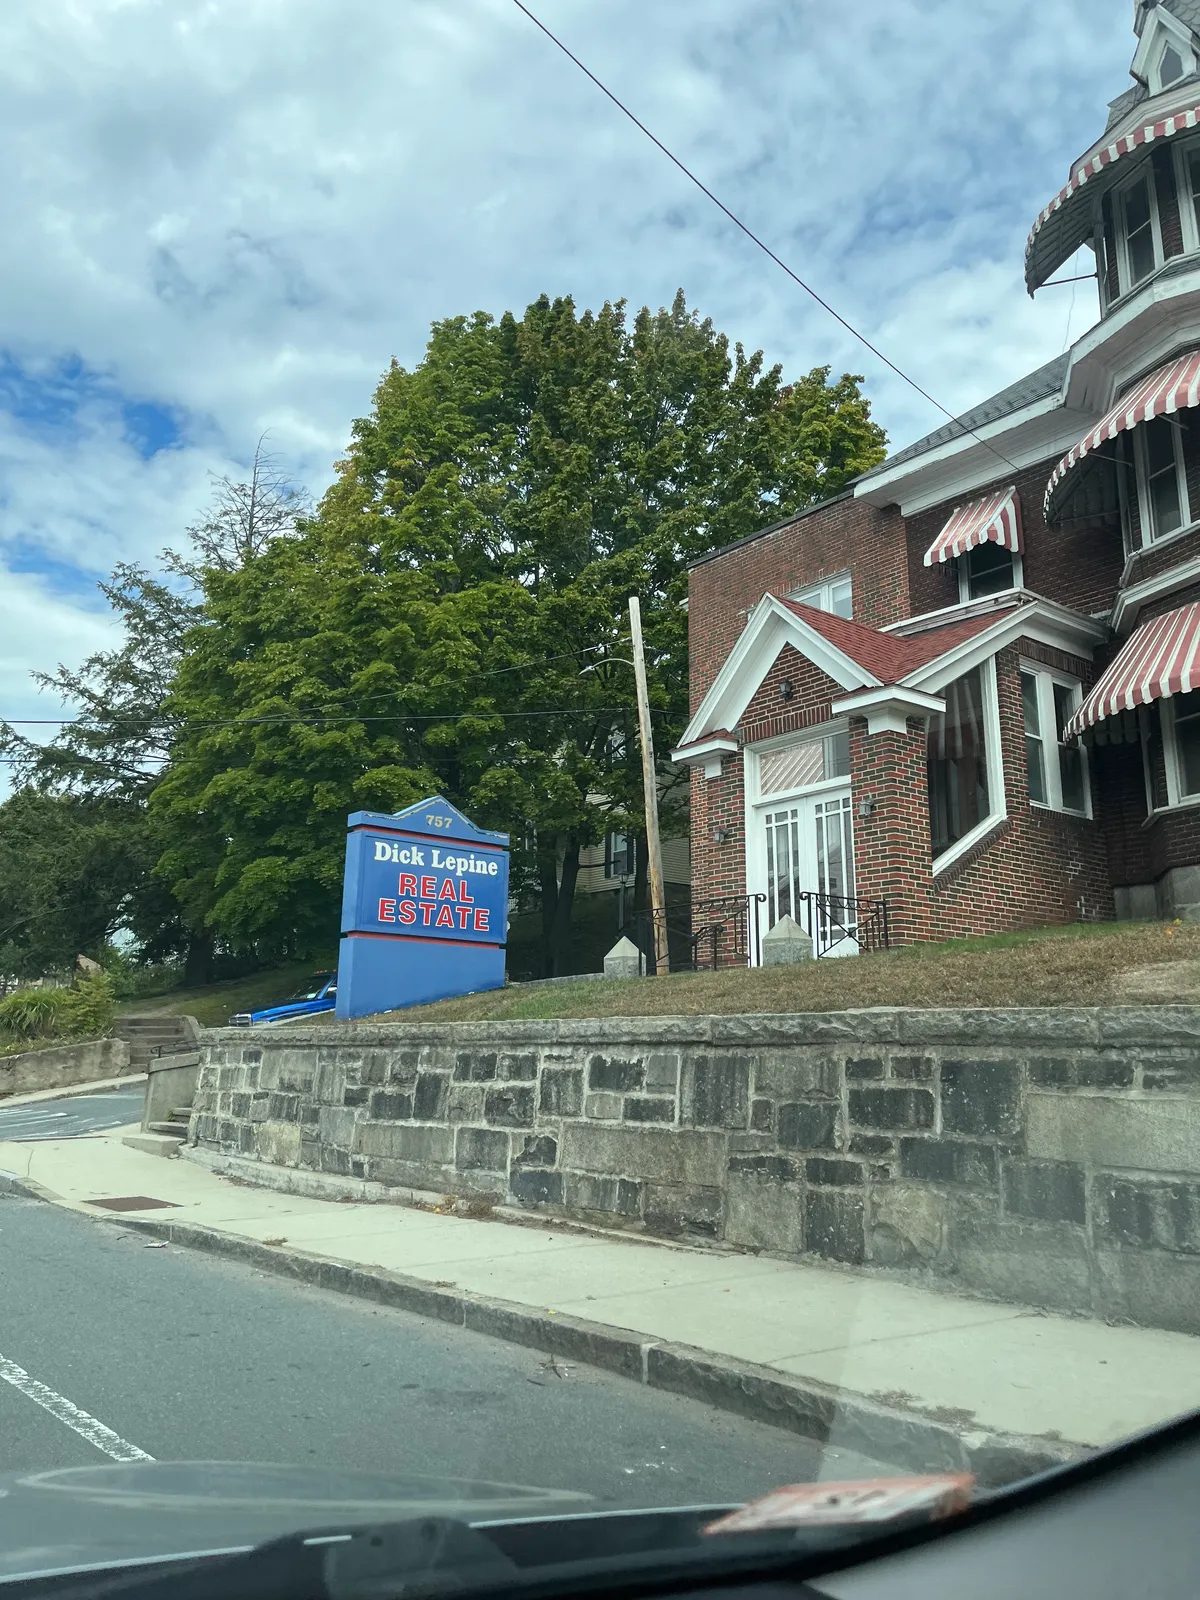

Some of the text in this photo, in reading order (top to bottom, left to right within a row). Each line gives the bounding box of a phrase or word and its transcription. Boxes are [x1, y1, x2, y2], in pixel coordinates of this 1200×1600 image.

[426, 815, 453, 828] 757
[374, 841, 498, 876] Dick Lepine
[398, 872, 474, 903] REAL
[378, 897, 490, 932] ESTATE
